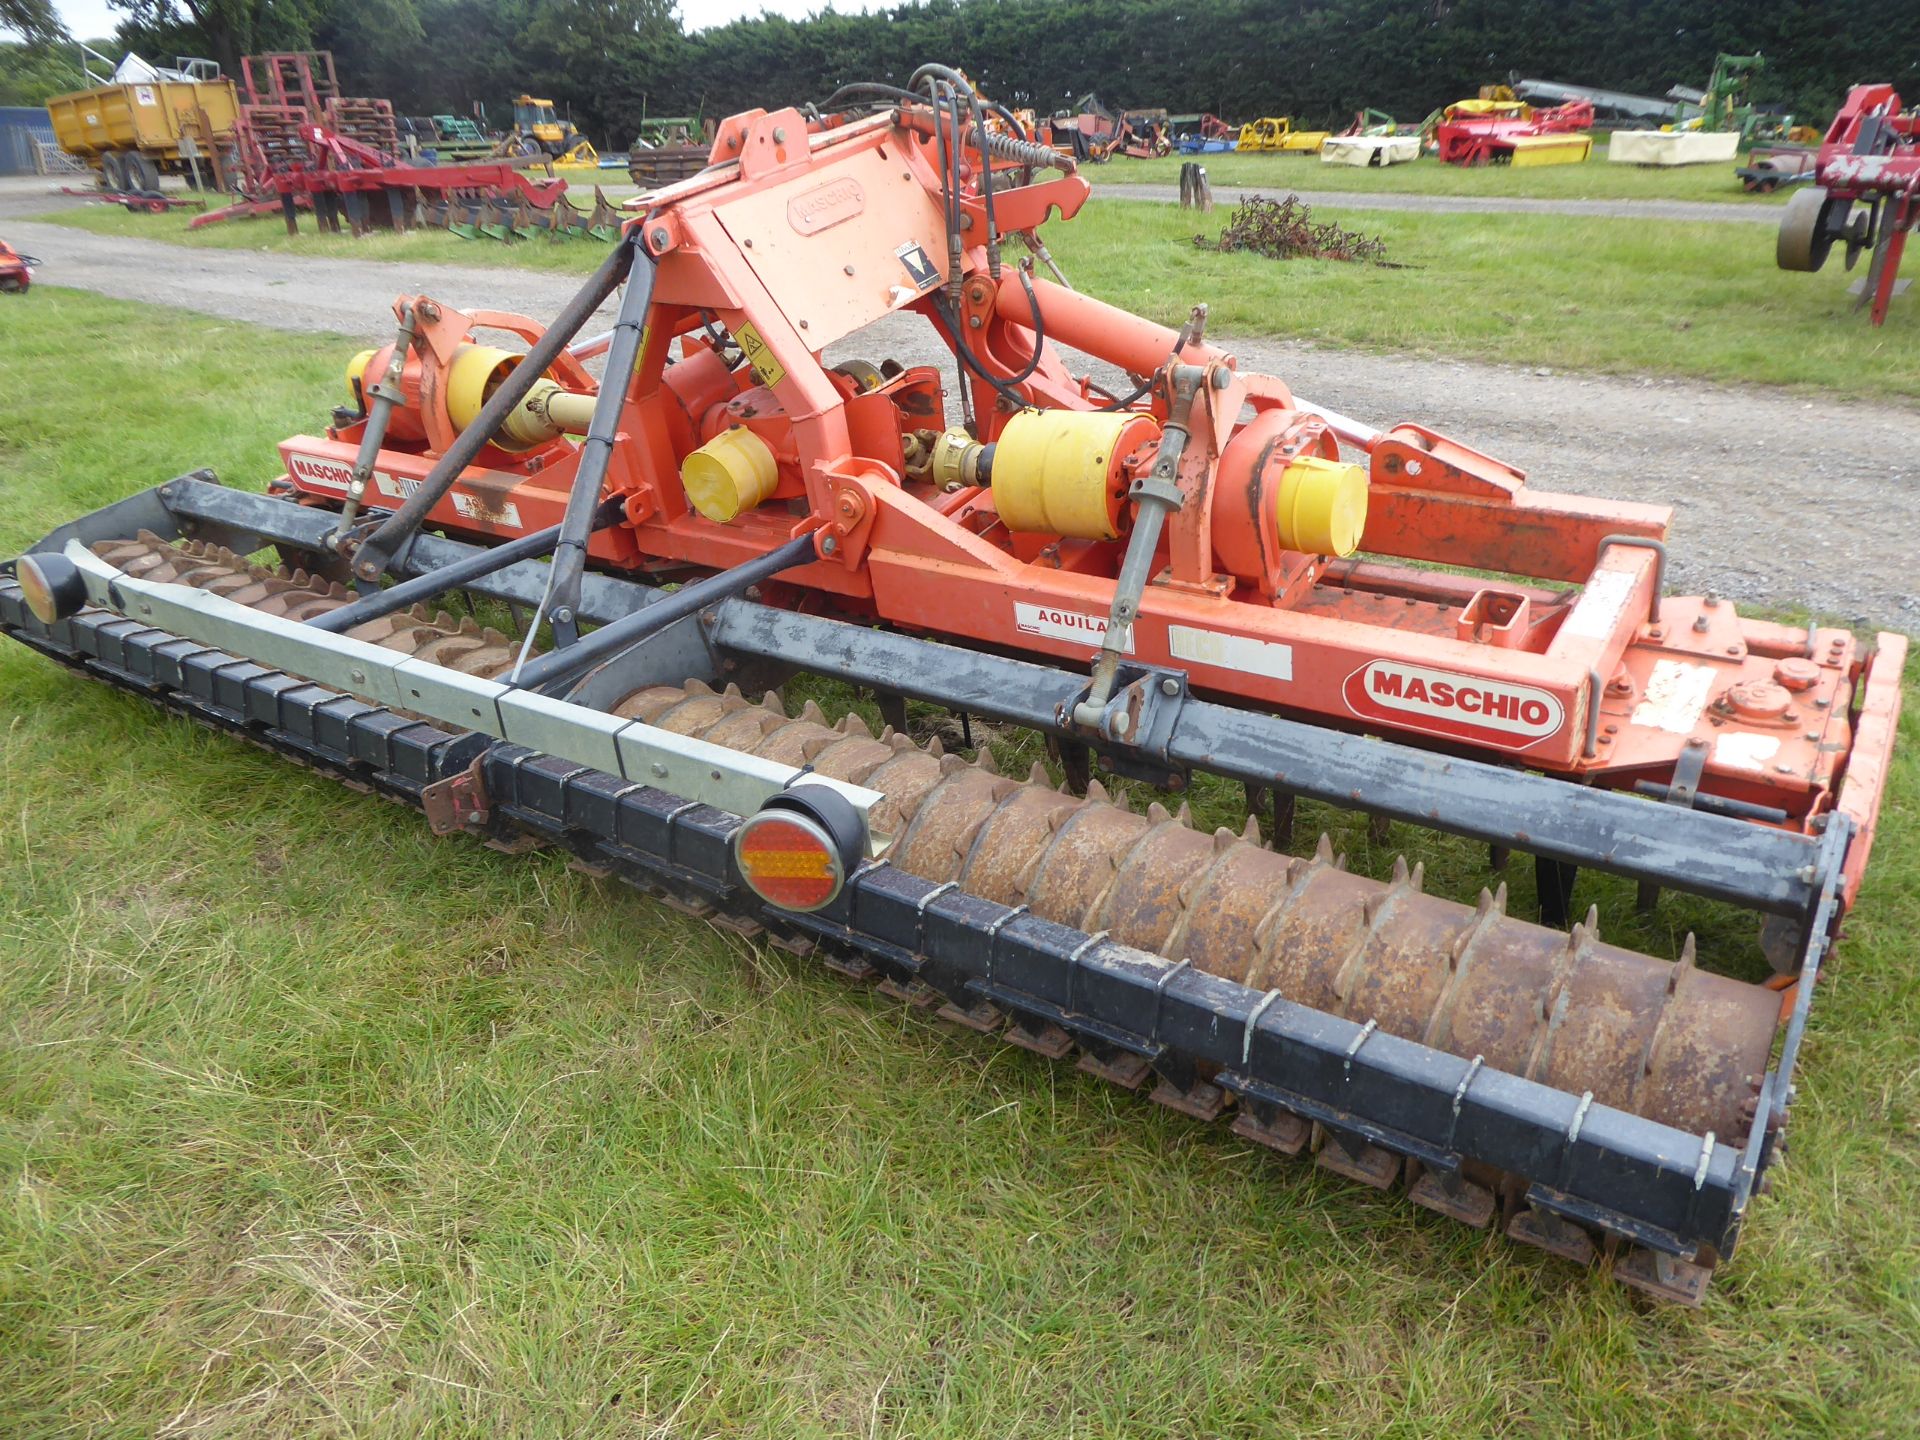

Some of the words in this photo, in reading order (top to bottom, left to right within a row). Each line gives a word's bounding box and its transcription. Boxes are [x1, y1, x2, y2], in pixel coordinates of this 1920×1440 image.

[294, 460, 352, 483] MASCHIO
[1038, 610, 1107, 633] AQUILA
[1373, 670, 1550, 726] MASCHIO
